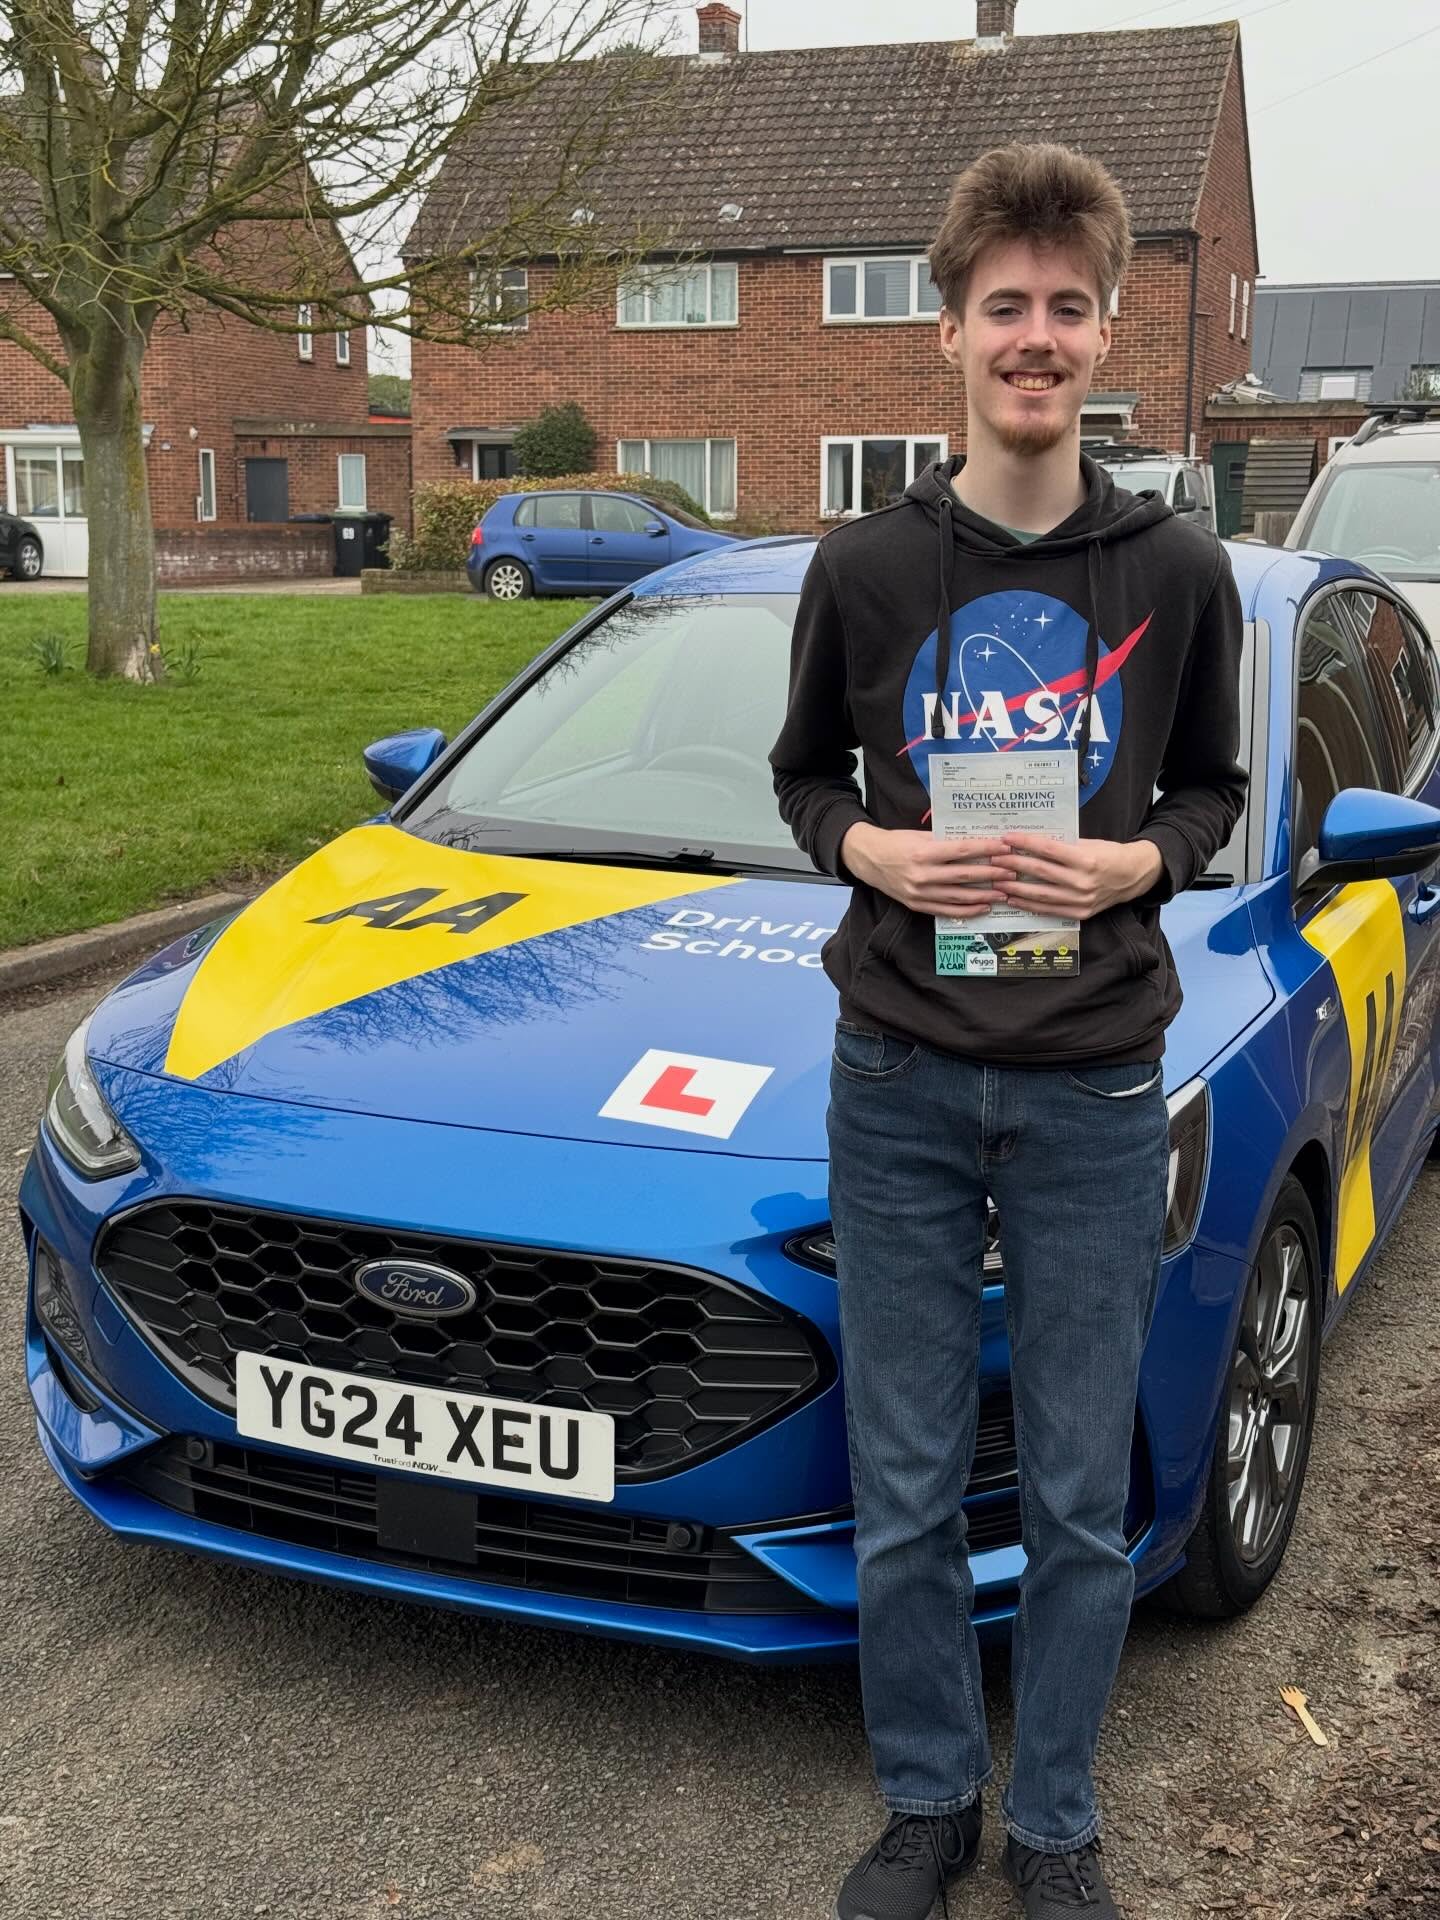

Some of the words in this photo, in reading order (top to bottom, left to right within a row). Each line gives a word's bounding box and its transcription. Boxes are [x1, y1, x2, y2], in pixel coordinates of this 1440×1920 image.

[921, 691, 1110, 743] NASA
[952, 791, 1007, 801] PRACTICAL
[1009, 791, 1055, 801] DRIVING
[953, 801, 973, 810] TEST
[975, 801, 997, 809] PASS
[999, 800, 1056, 809] CERTIFICATE
[304, 887, 531, 934] AA
[664, 909, 838, 940] Drivin
[640, 932, 824, 969] Schoo
[938, 951, 966, 963] WIN
[640, 1065, 716, 1117] L
[381, 1271, 445, 1305] Ford
[259, 1364, 422, 1456] YG24
[445, 1400, 579, 1480] XEU
[373, 1454, 411, 1468] TrustFord
